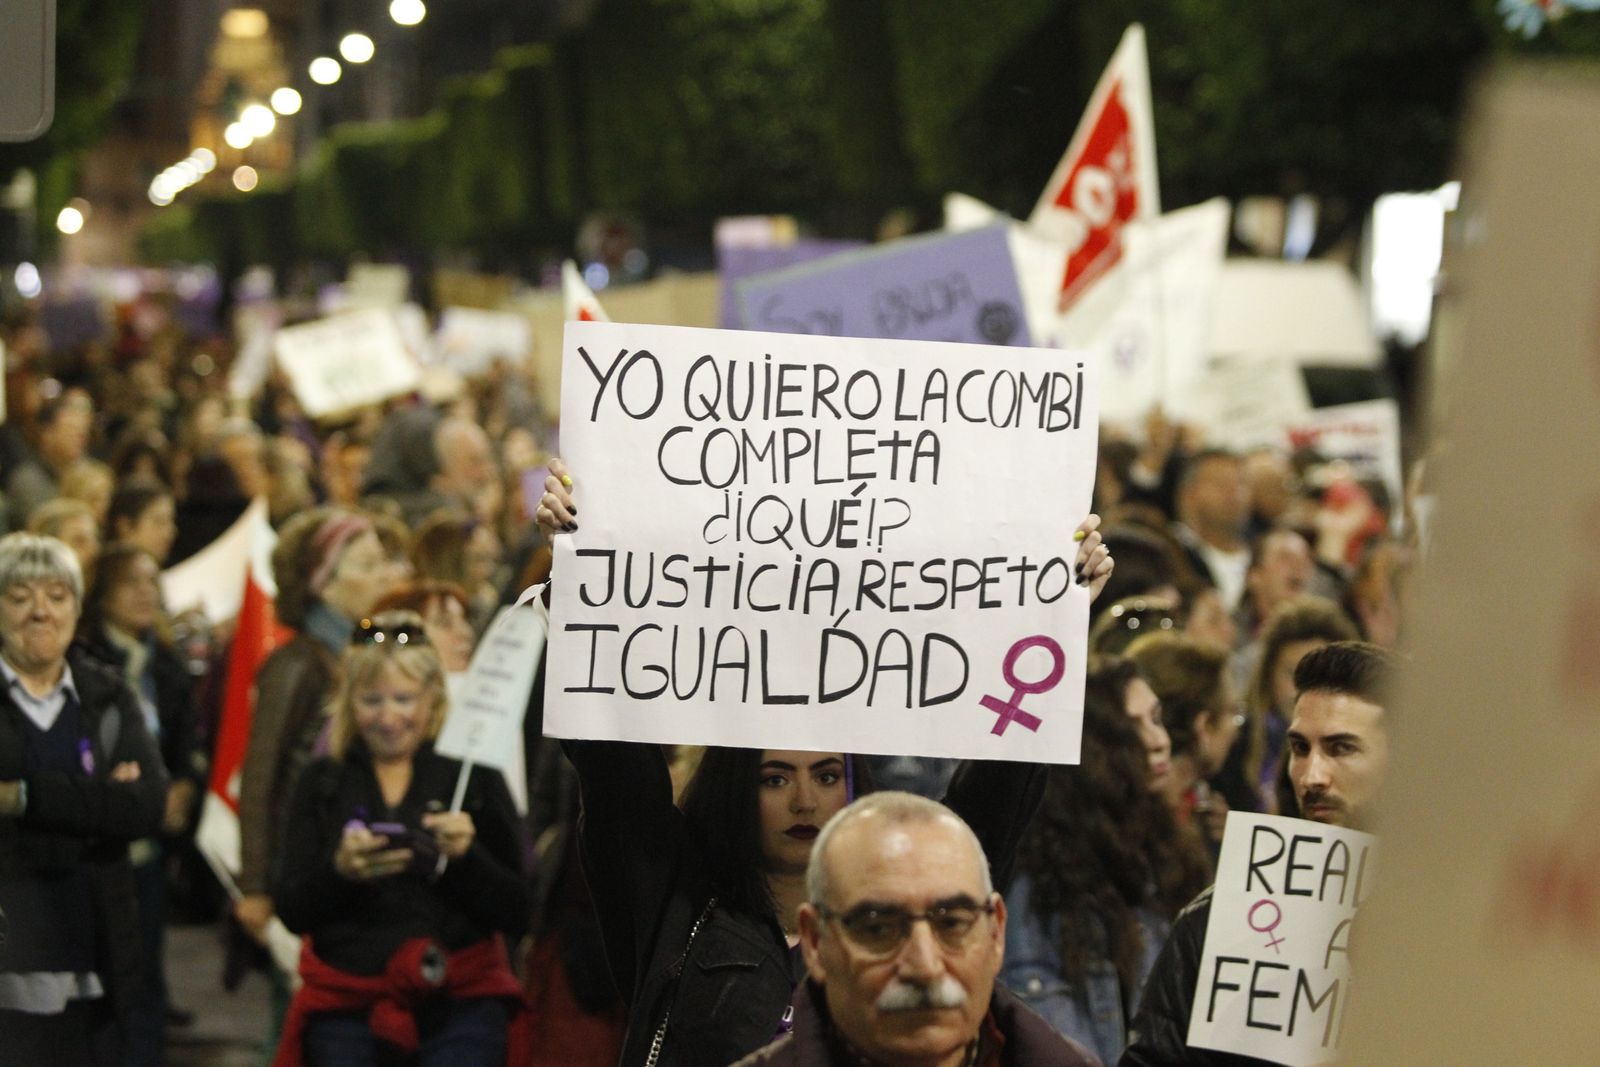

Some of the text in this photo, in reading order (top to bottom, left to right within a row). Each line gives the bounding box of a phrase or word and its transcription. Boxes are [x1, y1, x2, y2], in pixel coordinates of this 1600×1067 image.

[577, 346, 664, 422] YO
[895, 368, 948, 423] LA
[563, 623, 970, 710] IGUALDAD
